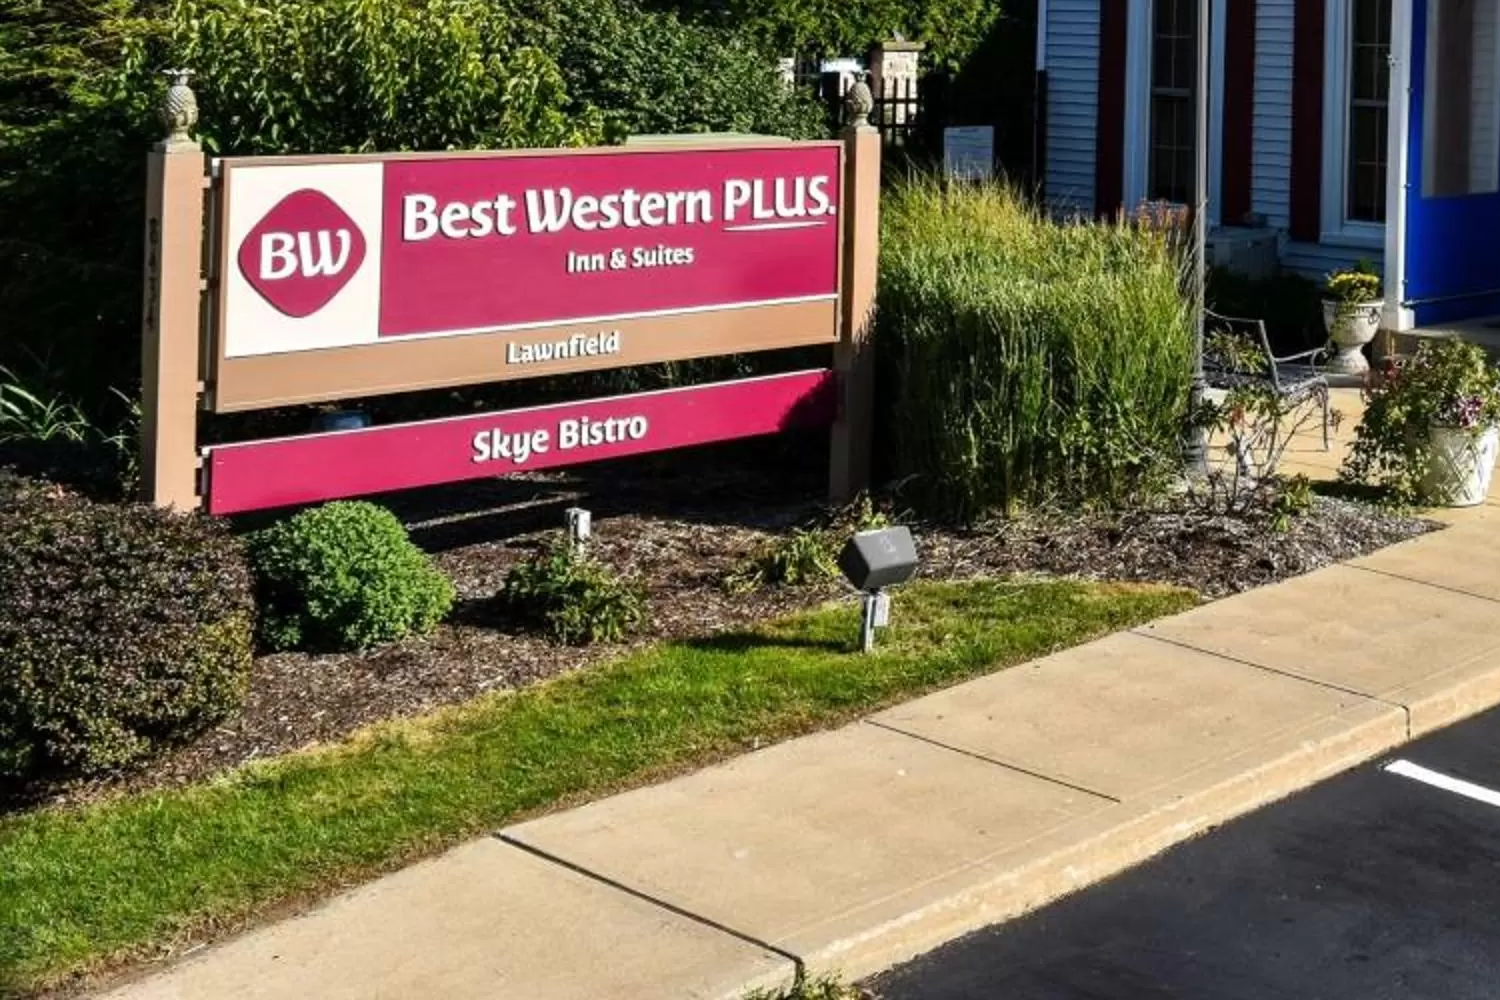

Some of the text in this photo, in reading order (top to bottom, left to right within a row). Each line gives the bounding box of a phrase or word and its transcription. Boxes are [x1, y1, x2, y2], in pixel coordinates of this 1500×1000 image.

[403, 193, 516, 240] Best
[524, 187, 713, 232] Western
[260, 229, 351, 280] BW
[567, 244, 695, 273] Inn & Suites
[507, 330, 621, 364] Lawnfield
[473, 415, 648, 463] Skye Bistro
